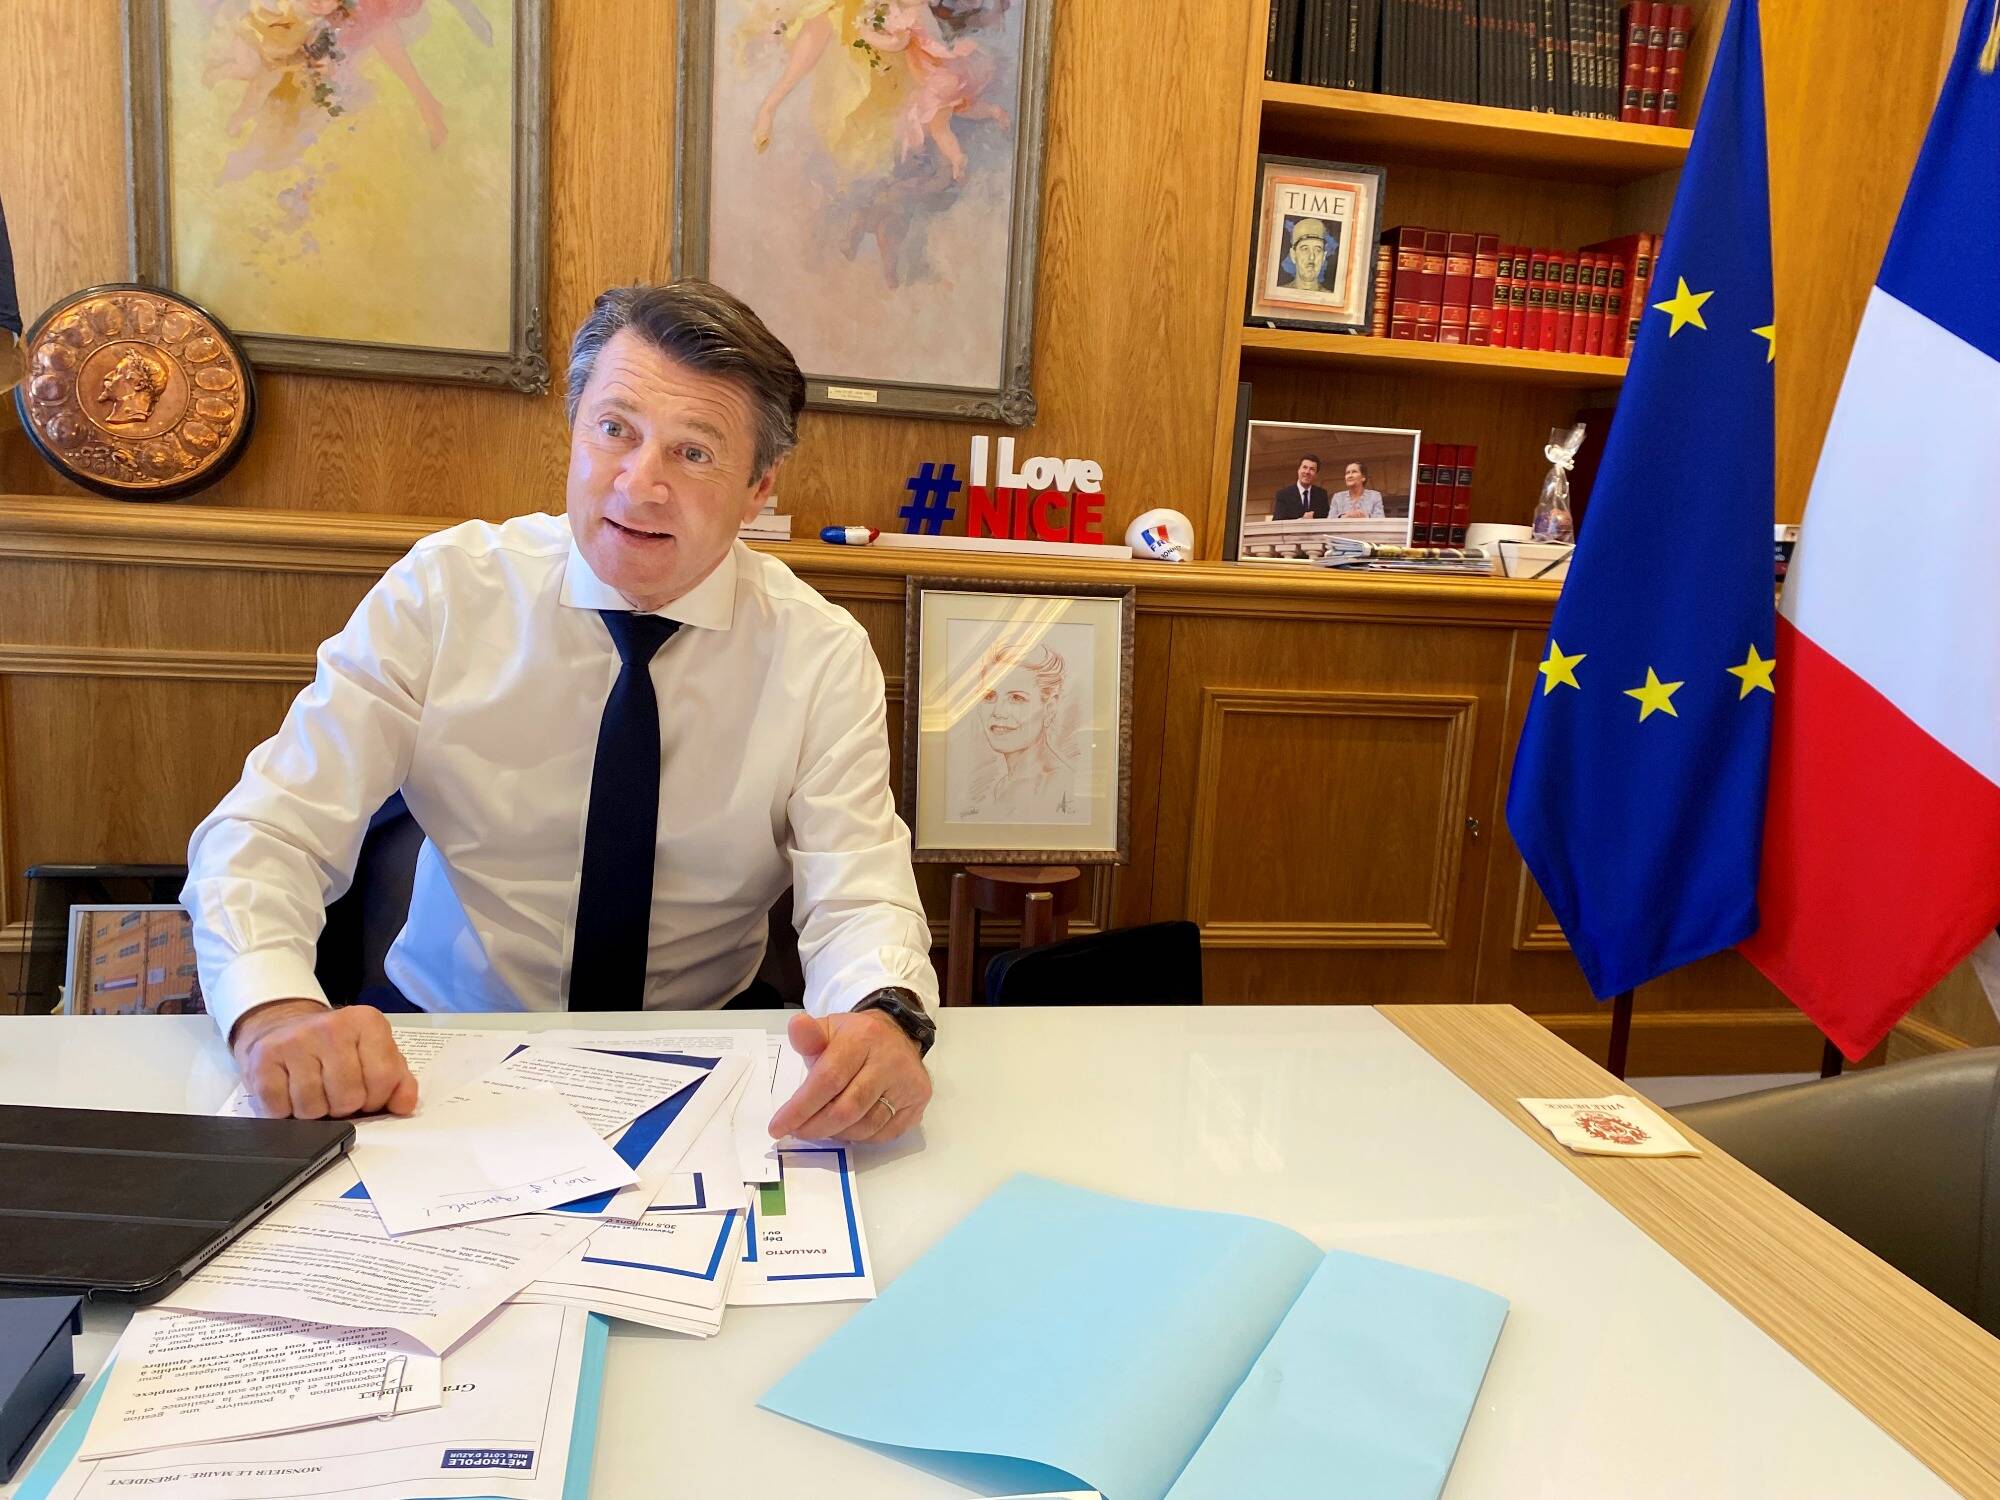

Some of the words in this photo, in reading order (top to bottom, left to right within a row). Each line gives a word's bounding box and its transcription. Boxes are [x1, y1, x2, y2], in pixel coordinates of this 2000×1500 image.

[1286, 191, 1345, 215] TIME
[970, 435, 989, 486] I
[995, 437, 1104, 493] Love
[967, 485, 1105, 545] NICE
[1592, 1103, 1625, 1111] VILLE
[615, 1218, 654, 1227] millions
[657, 1222, 677, 1230] 30,5
[632, 1226, 674, 1234] Prévention
[765, 1248, 827, 1256] ÉVALUATIO
[167, 1324, 206, 1334] culturel
[250, 1325, 292, 1334] millions
[152, 1332, 195, 1341] sécurité,
[168, 1337, 193, 1346] pour
[201, 1332, 242, 1341] d'euros
[229, 1328, 310, 1344] investissements
[336, 1334, 365, 1342] tarifs
[158, 1340, 223, 1353] conséquents
[335, 1337, 387, 1349] maintenir
[199, 1349, 259, 1362] préservant
[250, 1353, 286, 1361] niveau
[299, 1350, 345, 1361] d'adapter
[330, 1356, 346, 1364] par
[349, 1351, 387, 1360] marqué
[142, 1358, 193, 1369] équilibre
[190, 1361, 229, 1370] service
[242, 1358, 286, 1369] stratégie
[272, 1361, 327, 1374] succession
[338, 1358, 386, 1370] Contexte
[150, 1365, 186, 1376] public
[174, 1367, 230, 1378] budgétaire
[224, 1371, 254, 1380] crises
[261, 1366, 333, 1382] international
[307, 1366, 386, 1383] développement
[137, 1375, 163, 1383] pour
[265, 1379, 305, 1390] durable
[324, 1372, 385, 1386] responsable
[194, 1380, 241, 1391] national
[310, 1380, 385, 1396] Détermination
[132, 1387, 190, 1398] complexe,
[239, 1388, 287, 1400] favoriser
[358, 1384, 413, 1400] BUDGET
[161, 1399, 214, 1410] résilience
[215, 1396, 274, 1410] poursuivre
[123, 1411, 164, 1422] gestion
[447, 1458, 527, 1467] MÉTROPOLE
[190, 1471, 234, 1479] MAIRE
[256, 1465, 323, 1476] MONSIEUR
[107, 1475, 180, 1485] PRÉSIDENT
